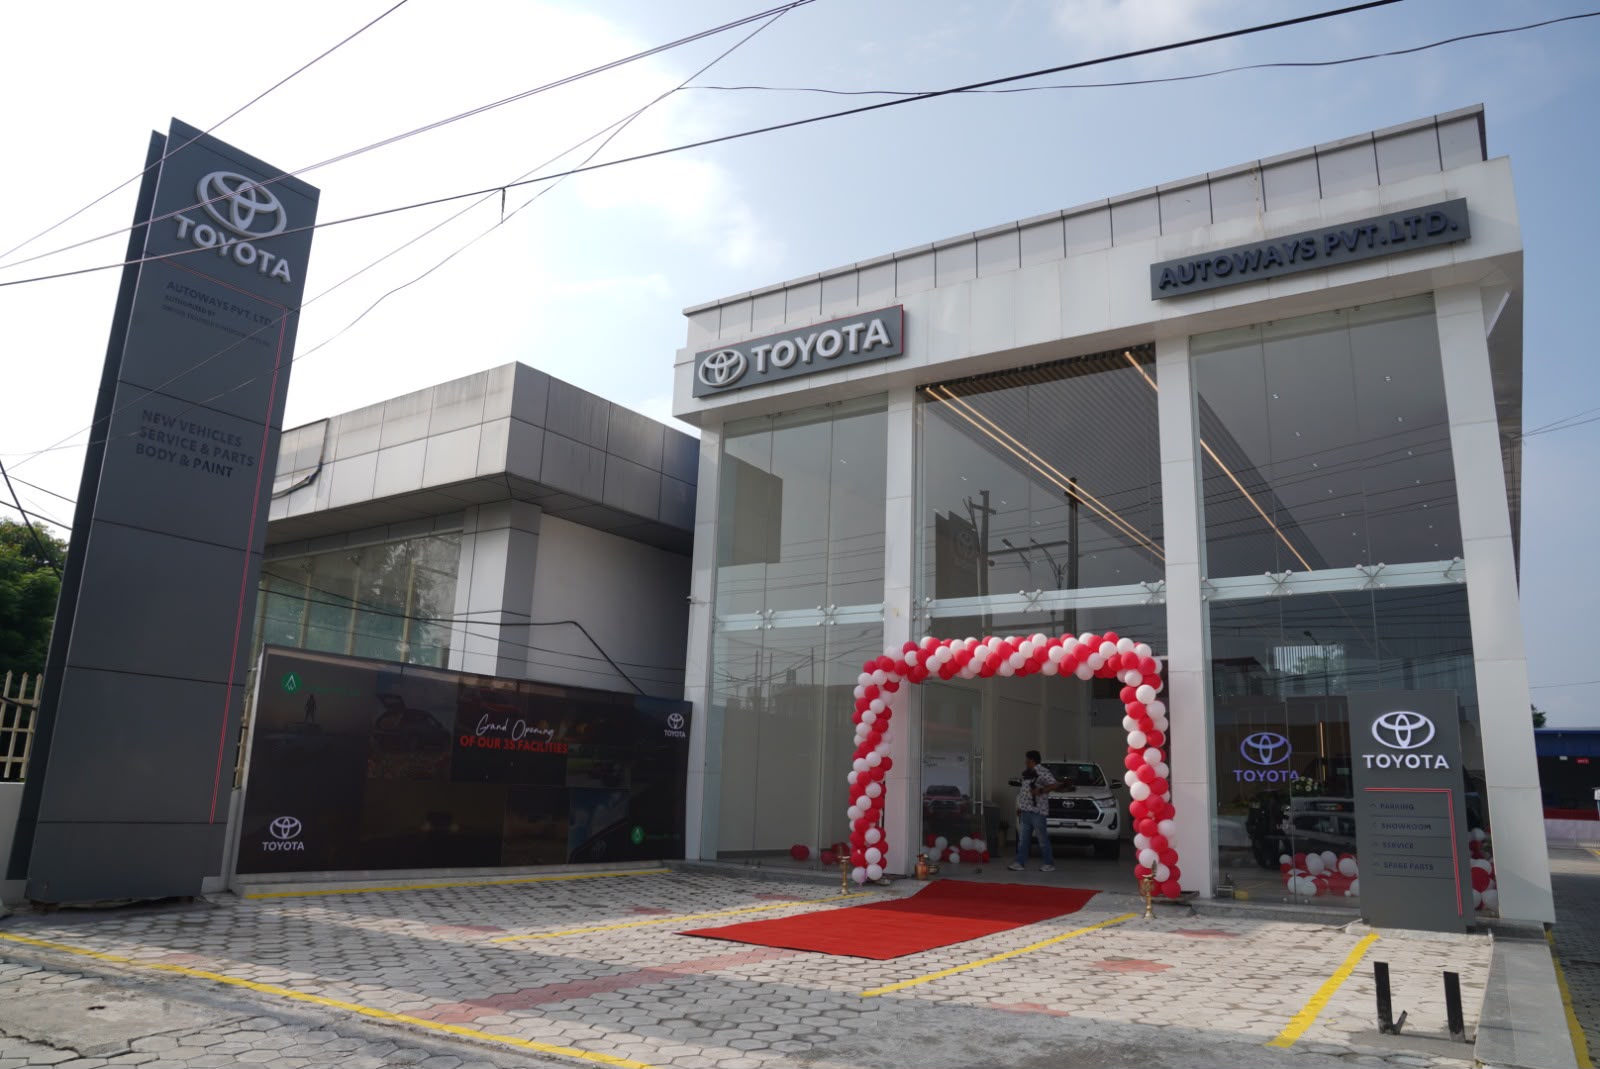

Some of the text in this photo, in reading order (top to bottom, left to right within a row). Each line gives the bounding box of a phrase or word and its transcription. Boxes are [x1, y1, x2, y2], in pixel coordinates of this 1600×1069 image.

[173, 214, 292, 284] TOYOTA
[1158, 236, 1318, 290] AUTOWAYS
[166, 281, 229, 311] AUTOWAYS
[230, 304, 252, 320] PVT.
[751, 318, 893, 373] TOYOTA
[142, 409, 243, 447] NEW VEHICLES
[140, 426, 255, 467] SERVICE & PARTS
[136, 443, 234, 478] BODY & PAINT
[475, 713, 555, 744] Grand Opening
[663, 729, 686, 738] TOYOTA
[459, 735, 476, 747] OF
[478, 737, 501, 749] OUR
[517, 741, 568, 754] FACILITIES
[1362, 754, 1450, 770] TOYOTA
[1234, 769, 1300, 783] TOYOTA
[1380, 803, 1415, 811] PARKING
[1381, 823, 1432, 831] SHOWROOM
[262, 841, 305, 852] TOYOTA
[1382, 841, 1414, 849] SERVICE
[1383, 861, 1434, 871] SPARE PARTS
